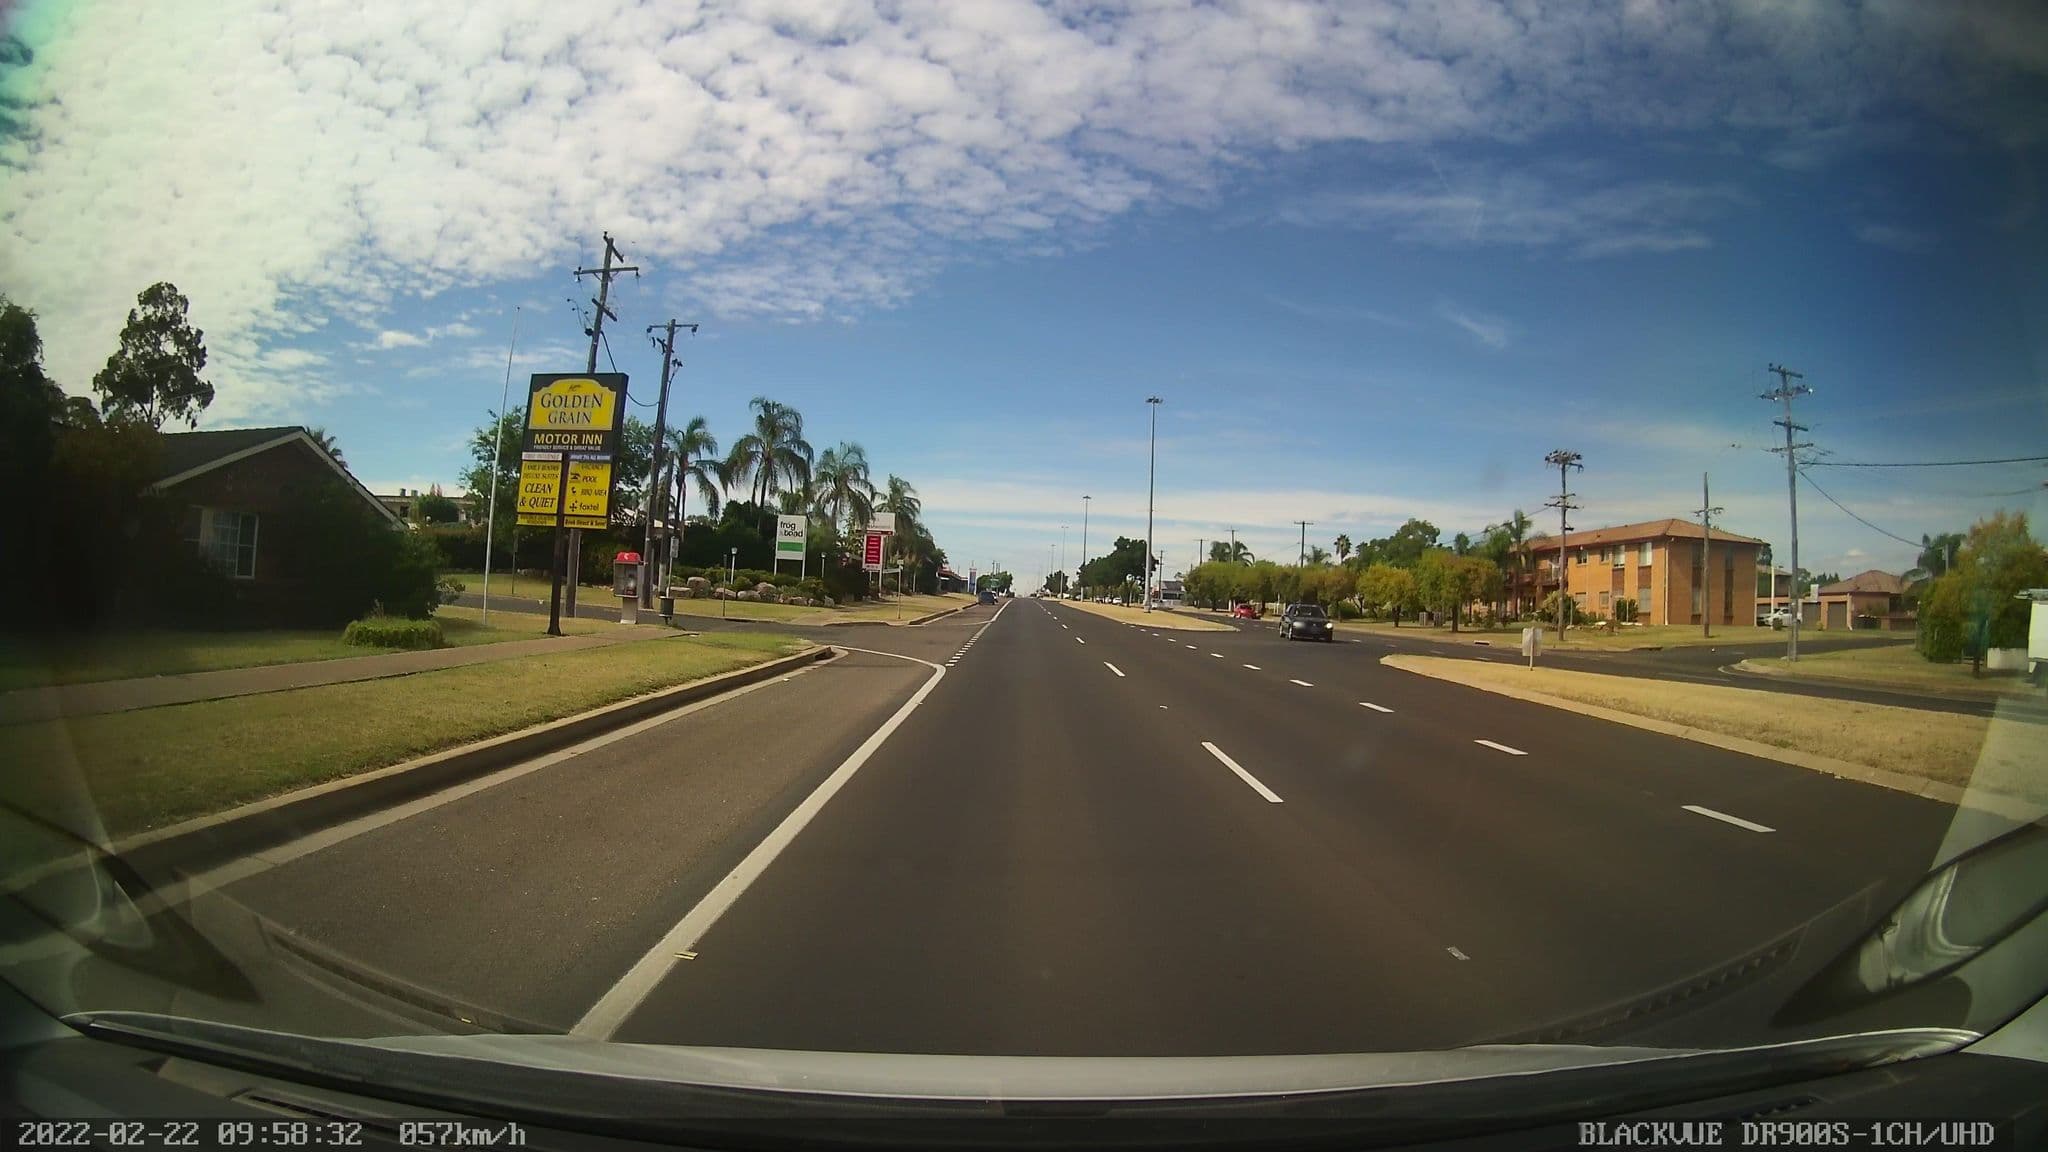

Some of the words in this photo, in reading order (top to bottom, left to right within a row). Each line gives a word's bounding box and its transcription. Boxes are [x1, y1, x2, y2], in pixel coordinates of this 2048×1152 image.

[541, 392, 603, 408] GOLDEN
[548, 411, 592, 424] GRAIN
[534, 433, 578, 444] MOTOR
[582, 433, 603, 445] INN
[525, 482, 553, 494] CLEAN
[519, 497, 526, 506] &
[528, 497, 557, 508] QUIET
[579, 503, 599, 511] foxtel
[780, 521, 796, 531] frog
